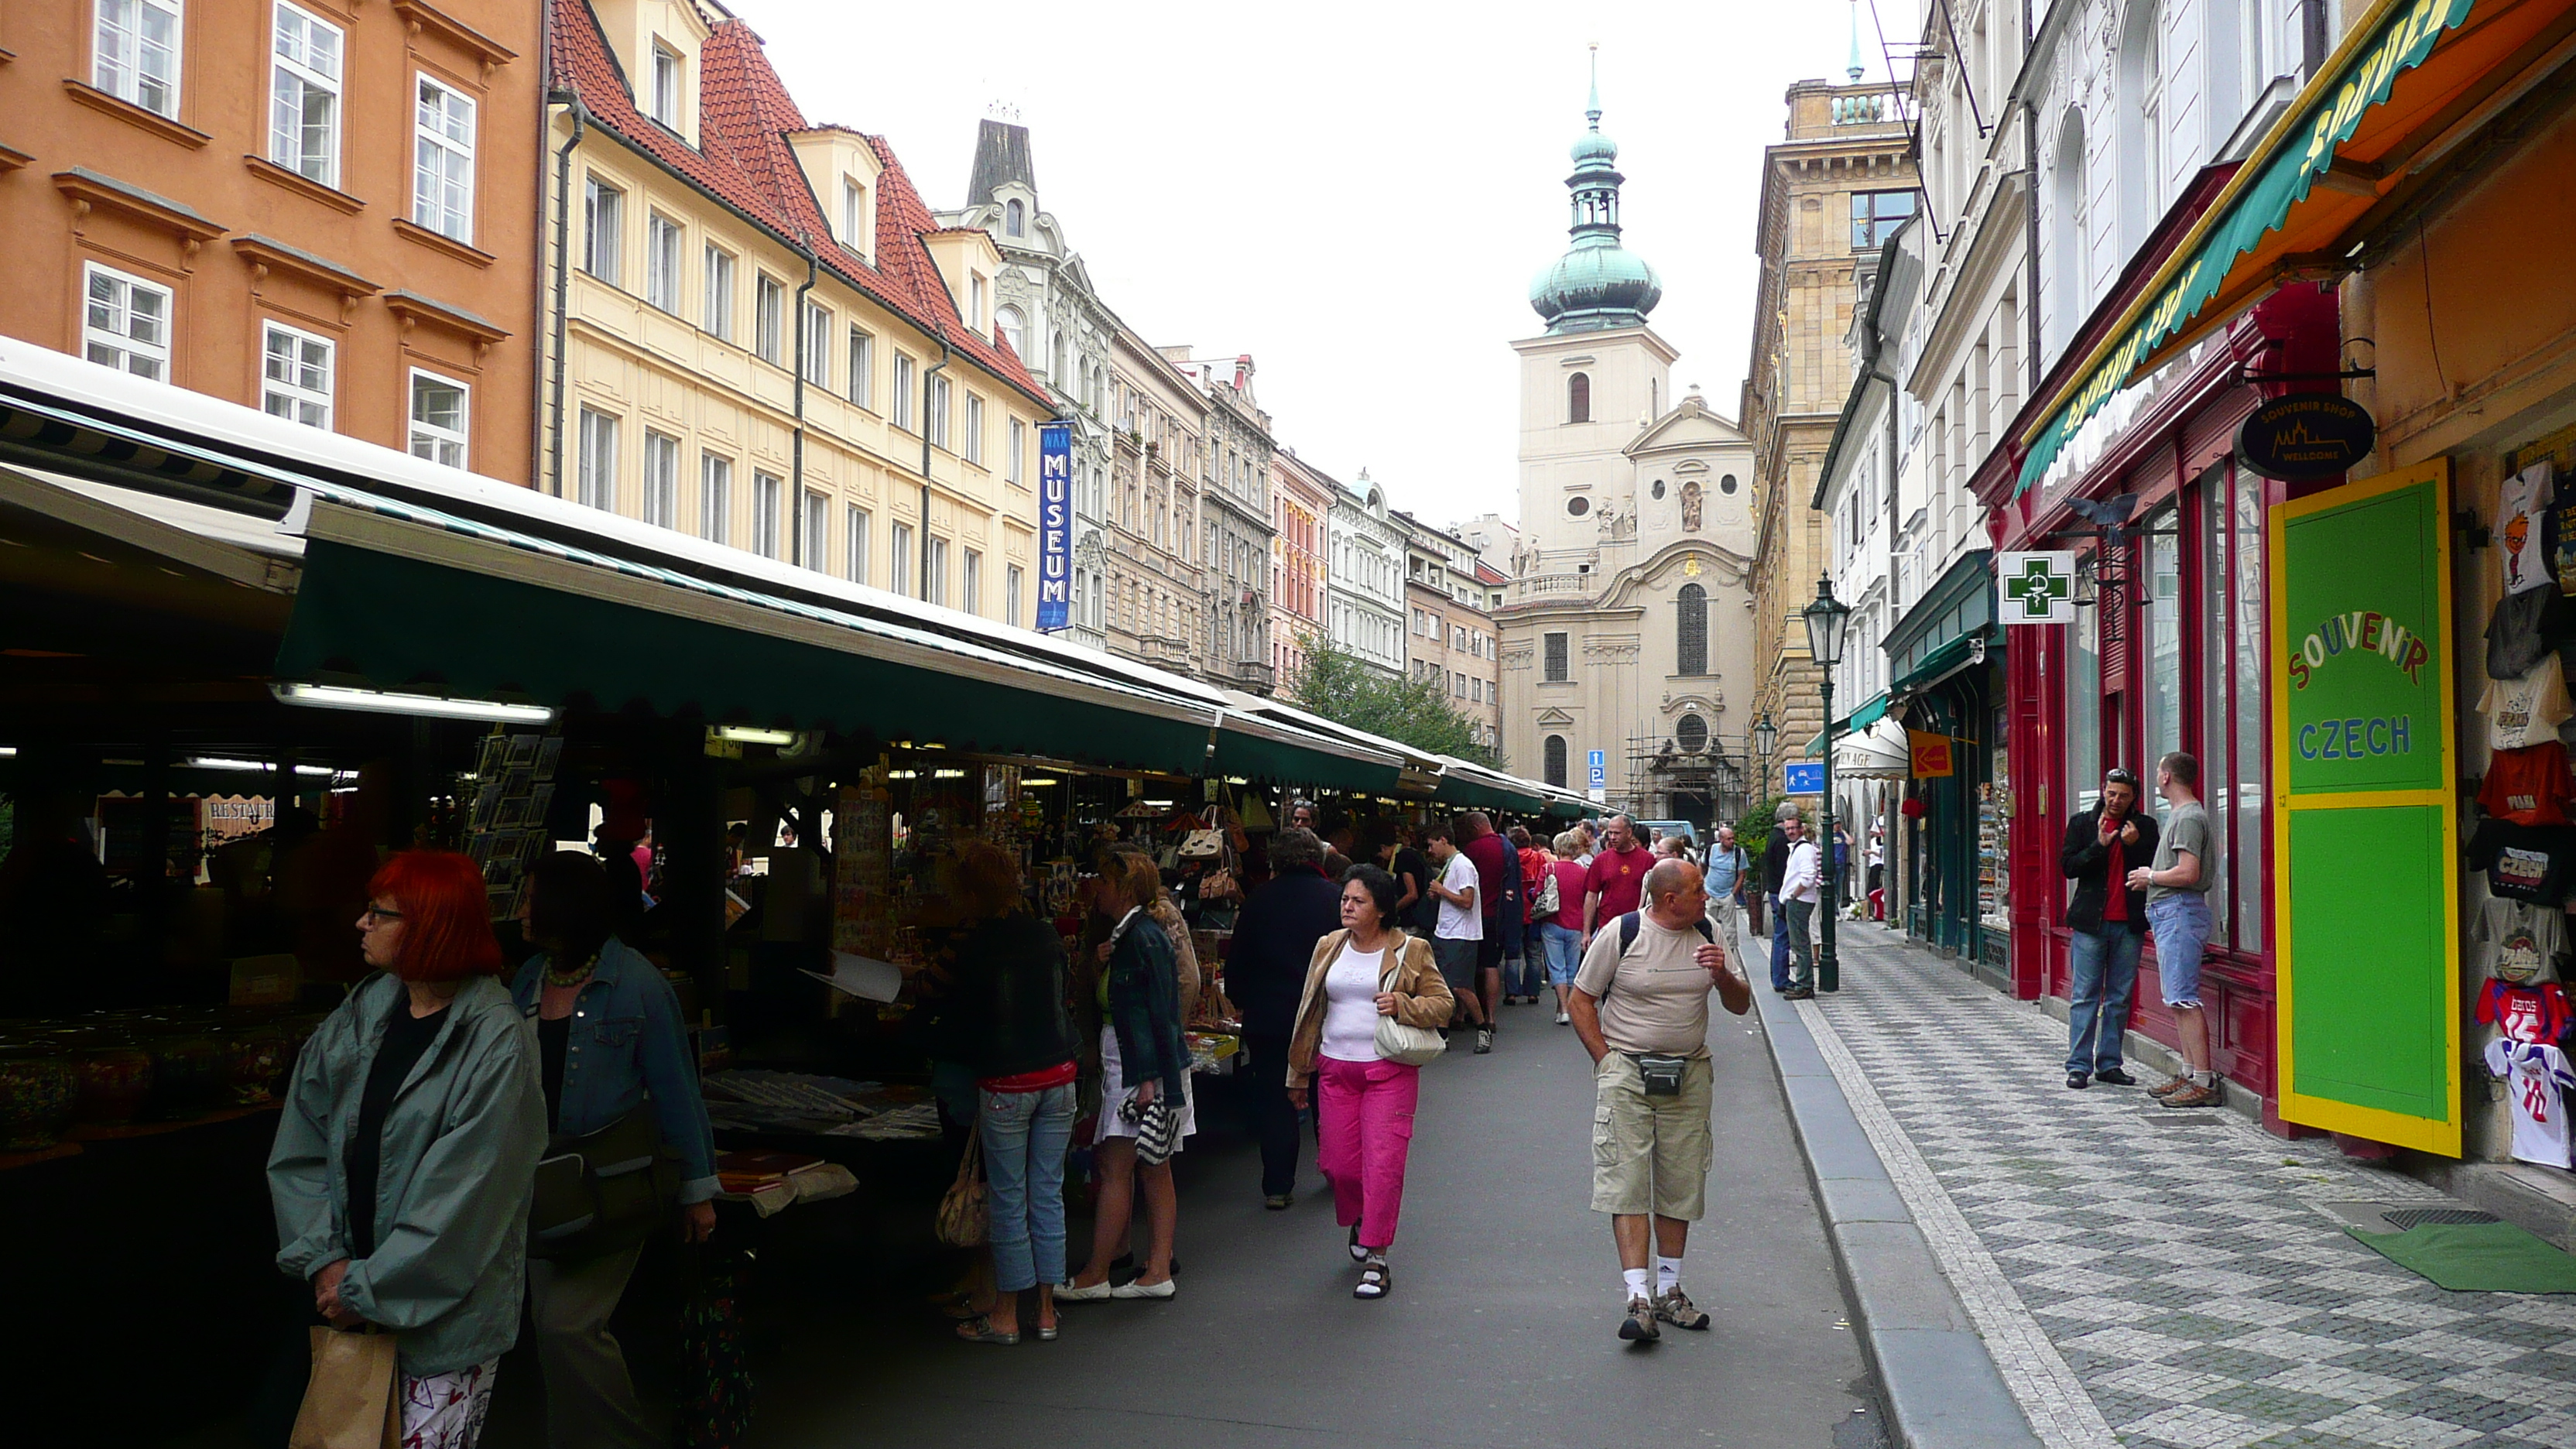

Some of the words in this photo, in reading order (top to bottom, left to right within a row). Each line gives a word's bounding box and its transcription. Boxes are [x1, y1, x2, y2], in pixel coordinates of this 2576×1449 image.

[2260, 400, 2321, 424] SOUVENIR
[2323, 401, 2357, 420] SHOP
[1043, 432, 1067, 449] WAX
[2283, 451, 2339, 462] WELLCOME
[1043, 454, 1067, 603] MUSEUM
[2298, 714, 2410, 762] CZECH
[1851, 752, 1872, 767] AGE
[1923, 754, 1946, 762] Kodak
[2499, 855, 2544, 879] CZECH
